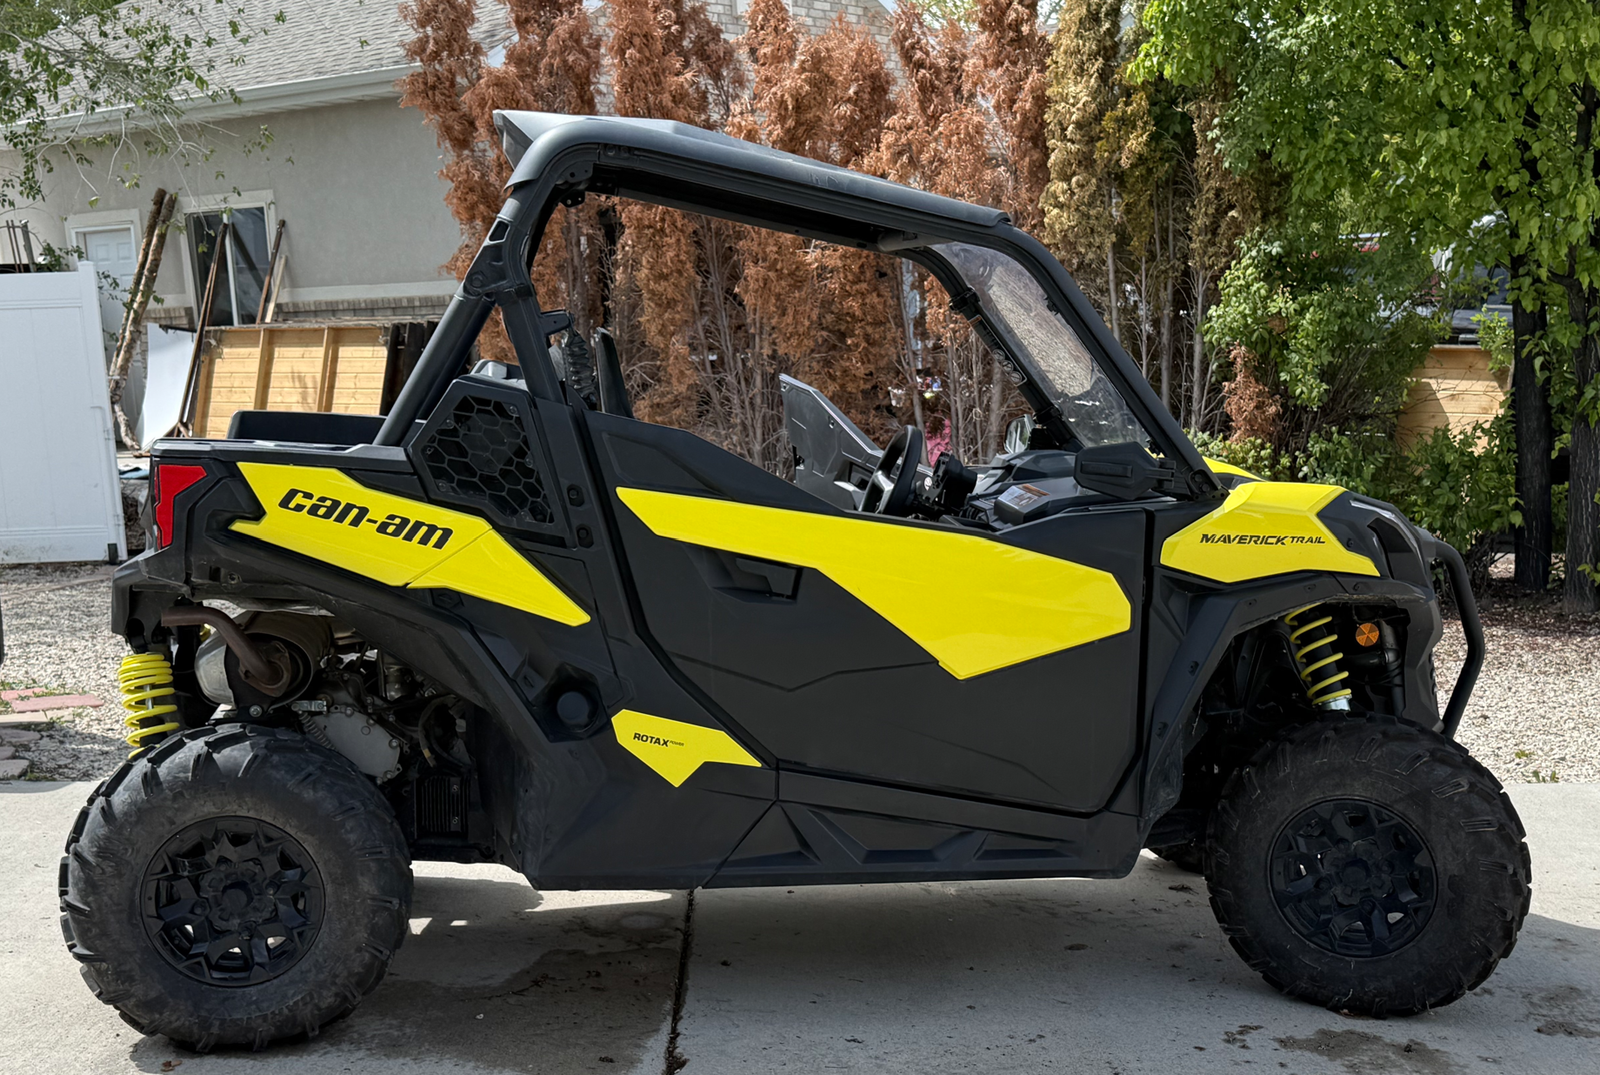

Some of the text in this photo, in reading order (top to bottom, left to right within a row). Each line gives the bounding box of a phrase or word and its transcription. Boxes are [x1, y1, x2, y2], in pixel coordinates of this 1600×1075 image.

[278, 488, 454, 550] can-am
[1200, 533, 1326, 546] MAVERICK TRAIL
[633, 732, 669, 747] ROTAX
